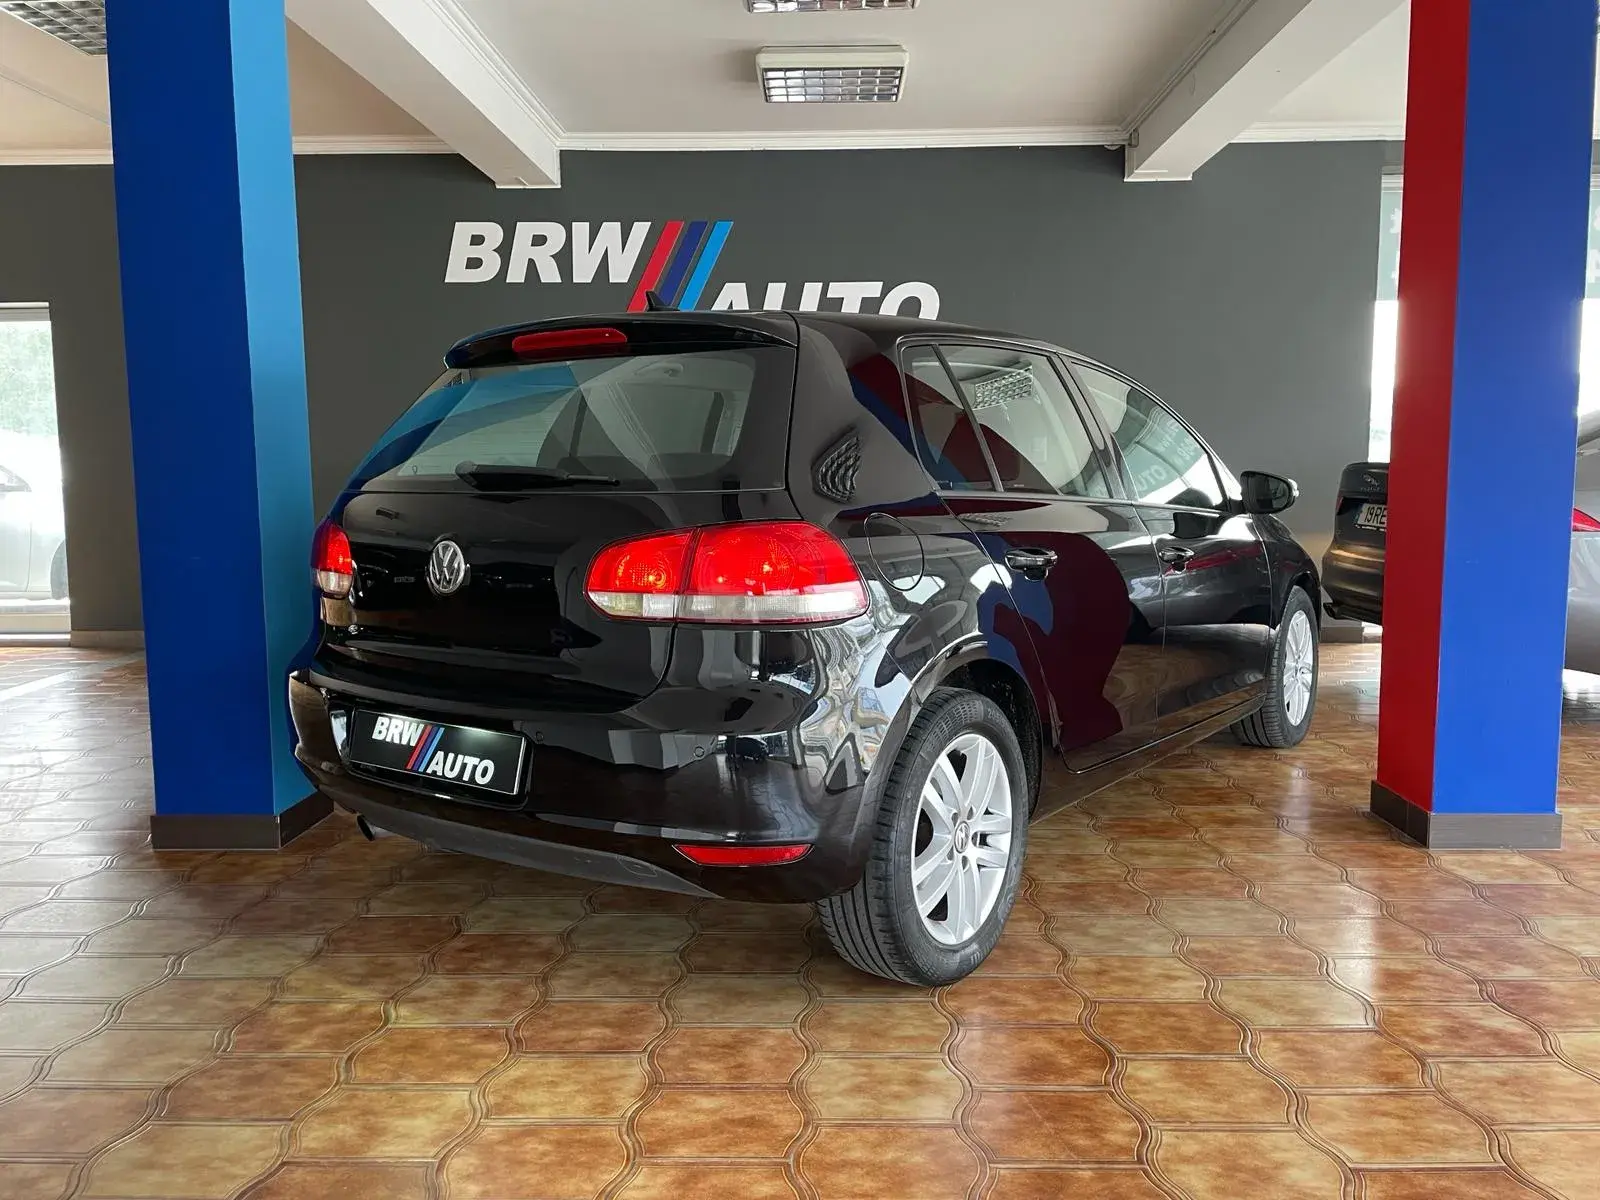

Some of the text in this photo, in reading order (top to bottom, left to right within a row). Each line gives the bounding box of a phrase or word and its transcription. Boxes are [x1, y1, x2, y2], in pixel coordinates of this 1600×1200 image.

[444, 221, 651, 284] BRW
[372, 716, 425, 747] BRW
[426, 750, 495, 785] AUTO
